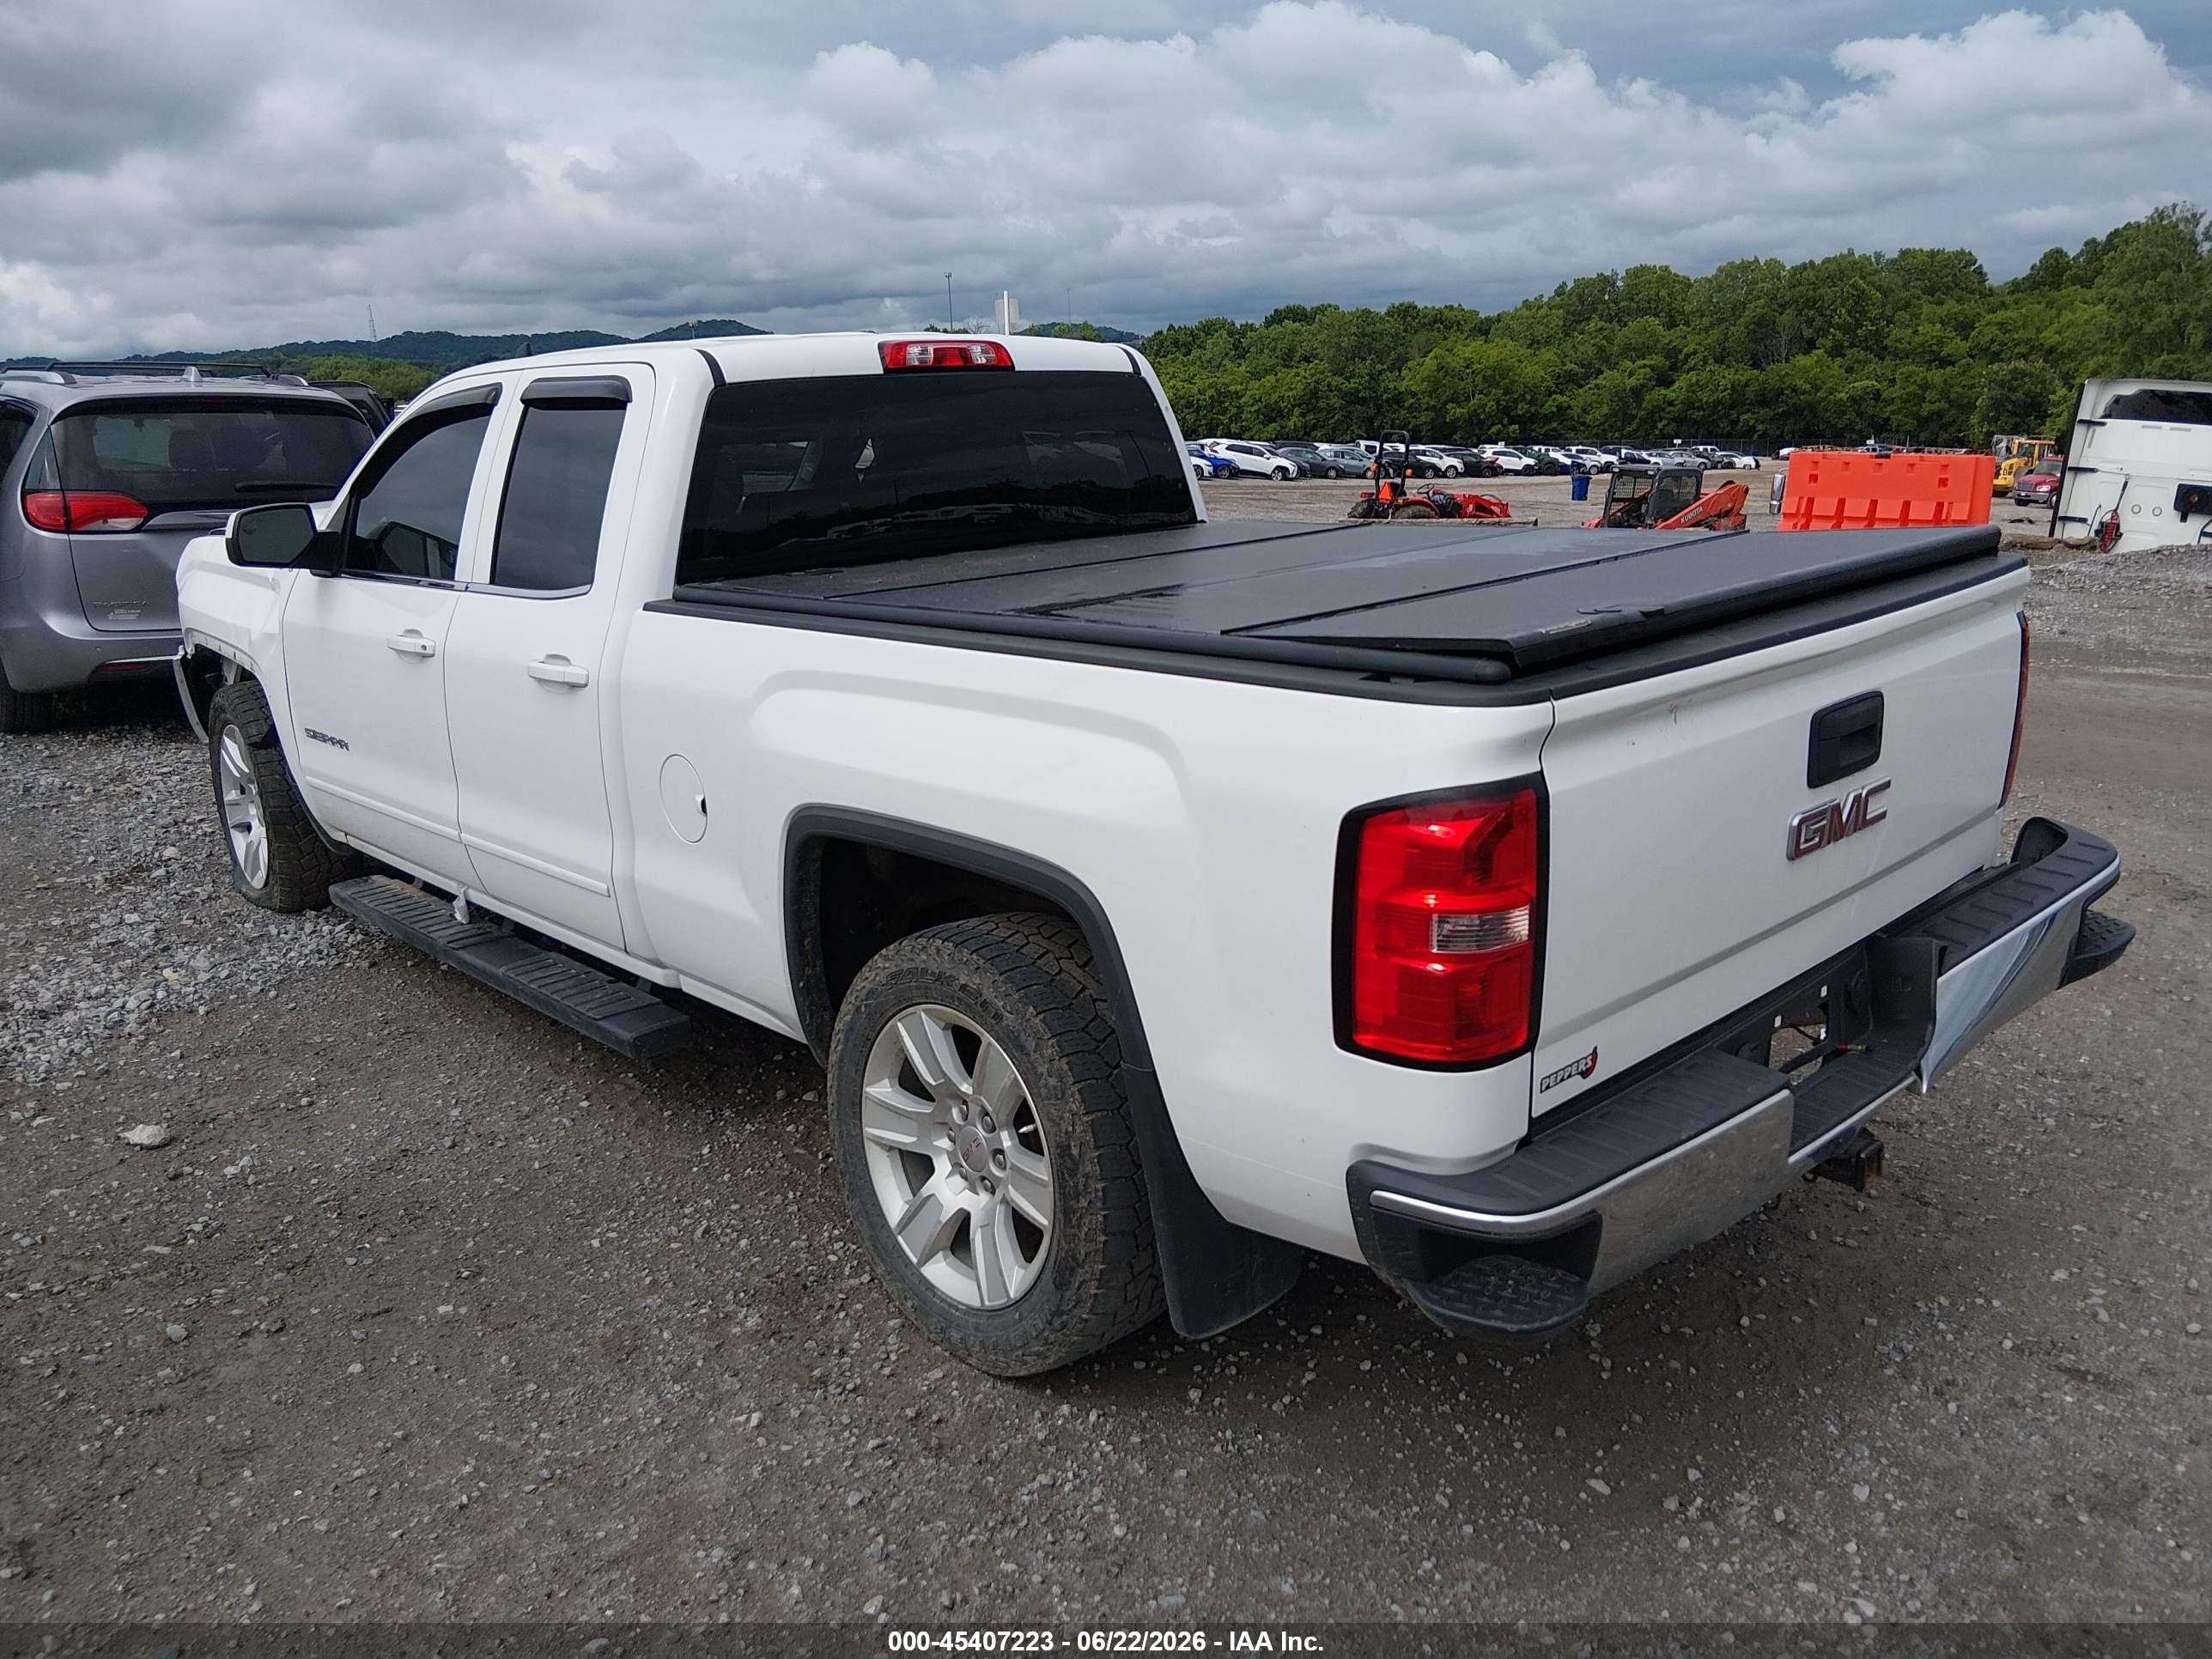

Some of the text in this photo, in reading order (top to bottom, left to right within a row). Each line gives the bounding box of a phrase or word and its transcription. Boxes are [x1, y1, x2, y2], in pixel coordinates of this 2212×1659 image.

[1680, 505, 1705, 525] KUBOTA
[304, 727, 350, 752] SIERRA
[1786, 776, 1892, 861] GMC
[1540, 1052, 1595, 1094] PEPPERS
